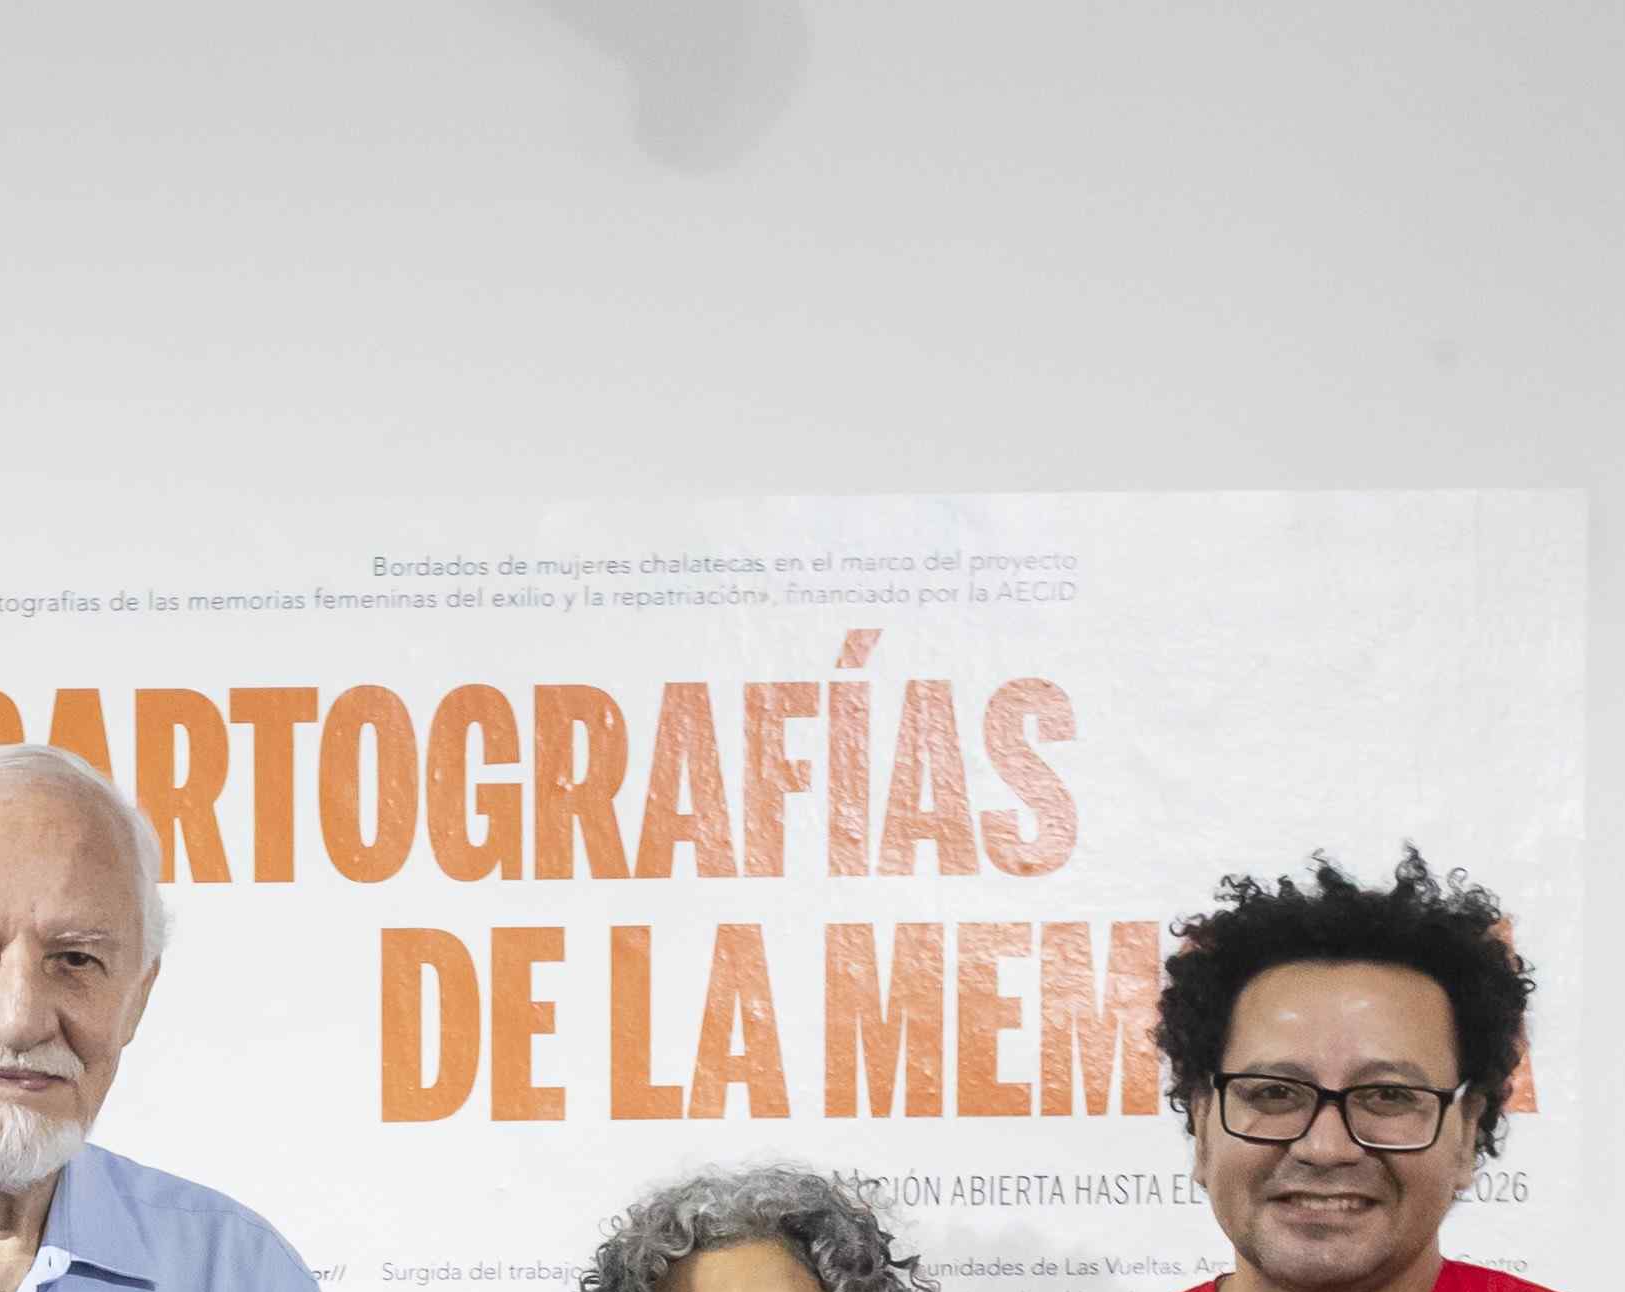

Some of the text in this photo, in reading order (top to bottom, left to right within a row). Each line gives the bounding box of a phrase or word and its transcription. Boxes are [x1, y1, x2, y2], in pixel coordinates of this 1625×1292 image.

[371, 550, 1079, 581] Bordados de mujeres chalatecas en el marco del proyecto
[108, 591, 141, 613] de
[148, 590, 181, 612] las
[188, 588, 306, 612] memorias
[313, 587, 439, 610] femeninas
[445, 586, 484, 609] del
[490, 585, 555, 609] exilio
[562, 590, 576, 614] y
[583, 585, 605, 608] la
[918, 588, 959, 610] por
[968, 581, 989, 602] la
[995, 581, 1078, 603] AECID
[379, 924, 567, 1123] DE
[609, 922, 792, 1120] LA
[951, 1174, 1067, 1206] ABIERTA
[1074, 1173, 1163, 1205] HASTA
[1173, 1174, 1203, 1204] EL
[382, 1262, 463, 1286] Surgida
[469, 1261, 502, 1281] del
[1030, 1257, 1058, 1275] de
[1065, 1257, 1098, 1275] Las
[1104, 1256, 1186, 1276] Vueltas,
